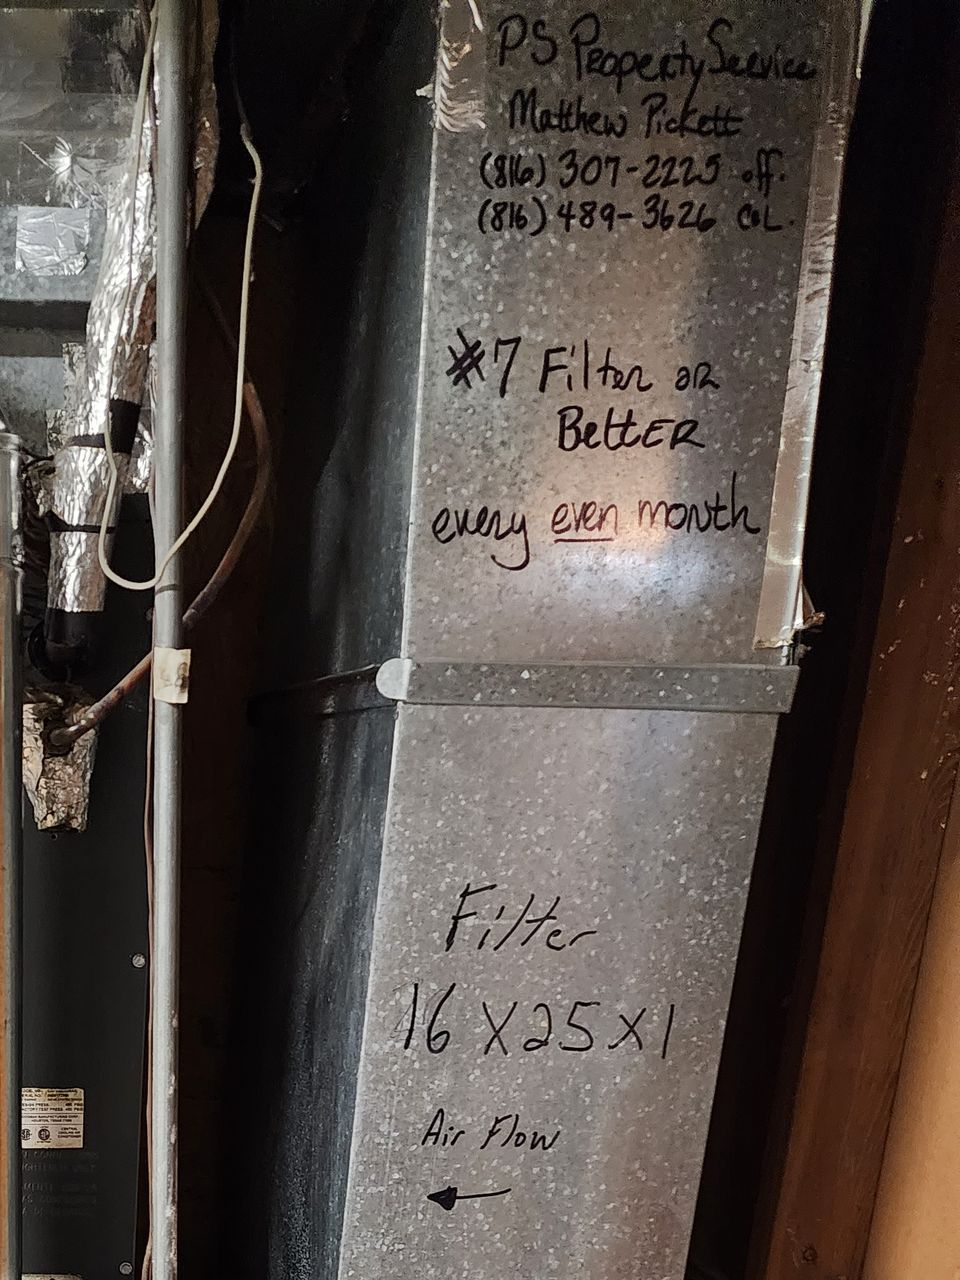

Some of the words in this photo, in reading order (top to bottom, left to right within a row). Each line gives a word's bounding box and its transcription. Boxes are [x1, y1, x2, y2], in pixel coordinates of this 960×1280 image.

[497, 13, 559, 67] PS
[509, 87, 629, 138] Matthew
[641, 92, 746, 139] Pickett
[479, 151, 547, 189] (816)
[558, 149, 722, 188] 307-2225
[477, 198, 547, 236] (816)
[557, 193, 717, 233] 489-3626
[446, 327, 523, 399] #7
[430, 504, 531, 571] every
[550, 500, 619, 535] even
[444, 882, 598, 952] Filter
[421, 1107, 466, 1146] Air
[479, 1113, 561, 1151] Flow
